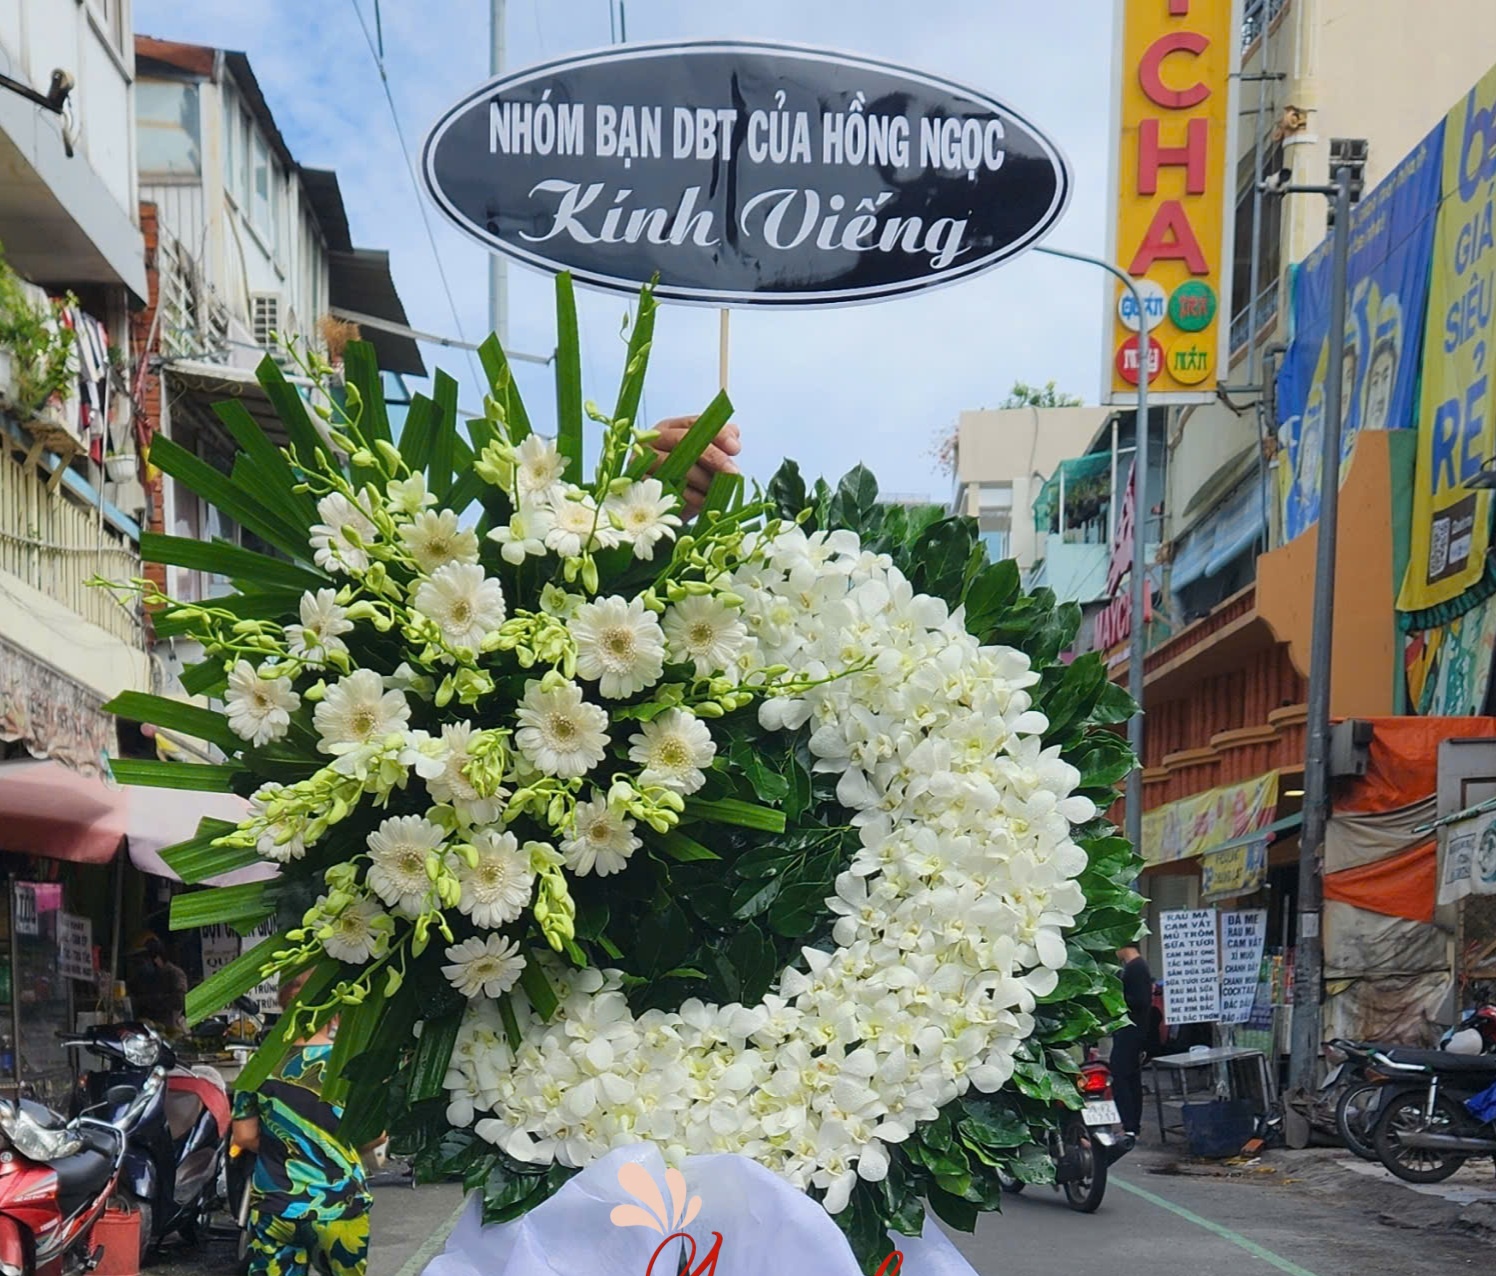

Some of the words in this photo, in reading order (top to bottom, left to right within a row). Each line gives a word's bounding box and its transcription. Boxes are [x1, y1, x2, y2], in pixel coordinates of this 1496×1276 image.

[489, 89, 584, 155] NHÓM
[596, 105, 663, 168] BẠN
[674, 109, 737, 161] DBT
[748, 90, 808, 164] CỦA
[823, 91, 910, 168] HỒNG
[920, 116, 1005, 181] NGỌC
[1128, 0, 1212, 276] CHA
[519, 179, 722, 246] Kính
[742, 188, 973, 269] Viếng
[1455, 181, 1494, 276] GIÁ
[1444, 270, 1494, 353] SIÊU
[1164, 922, 1188, 930] CAM
[1227, 938, 1246, 948] CAM
